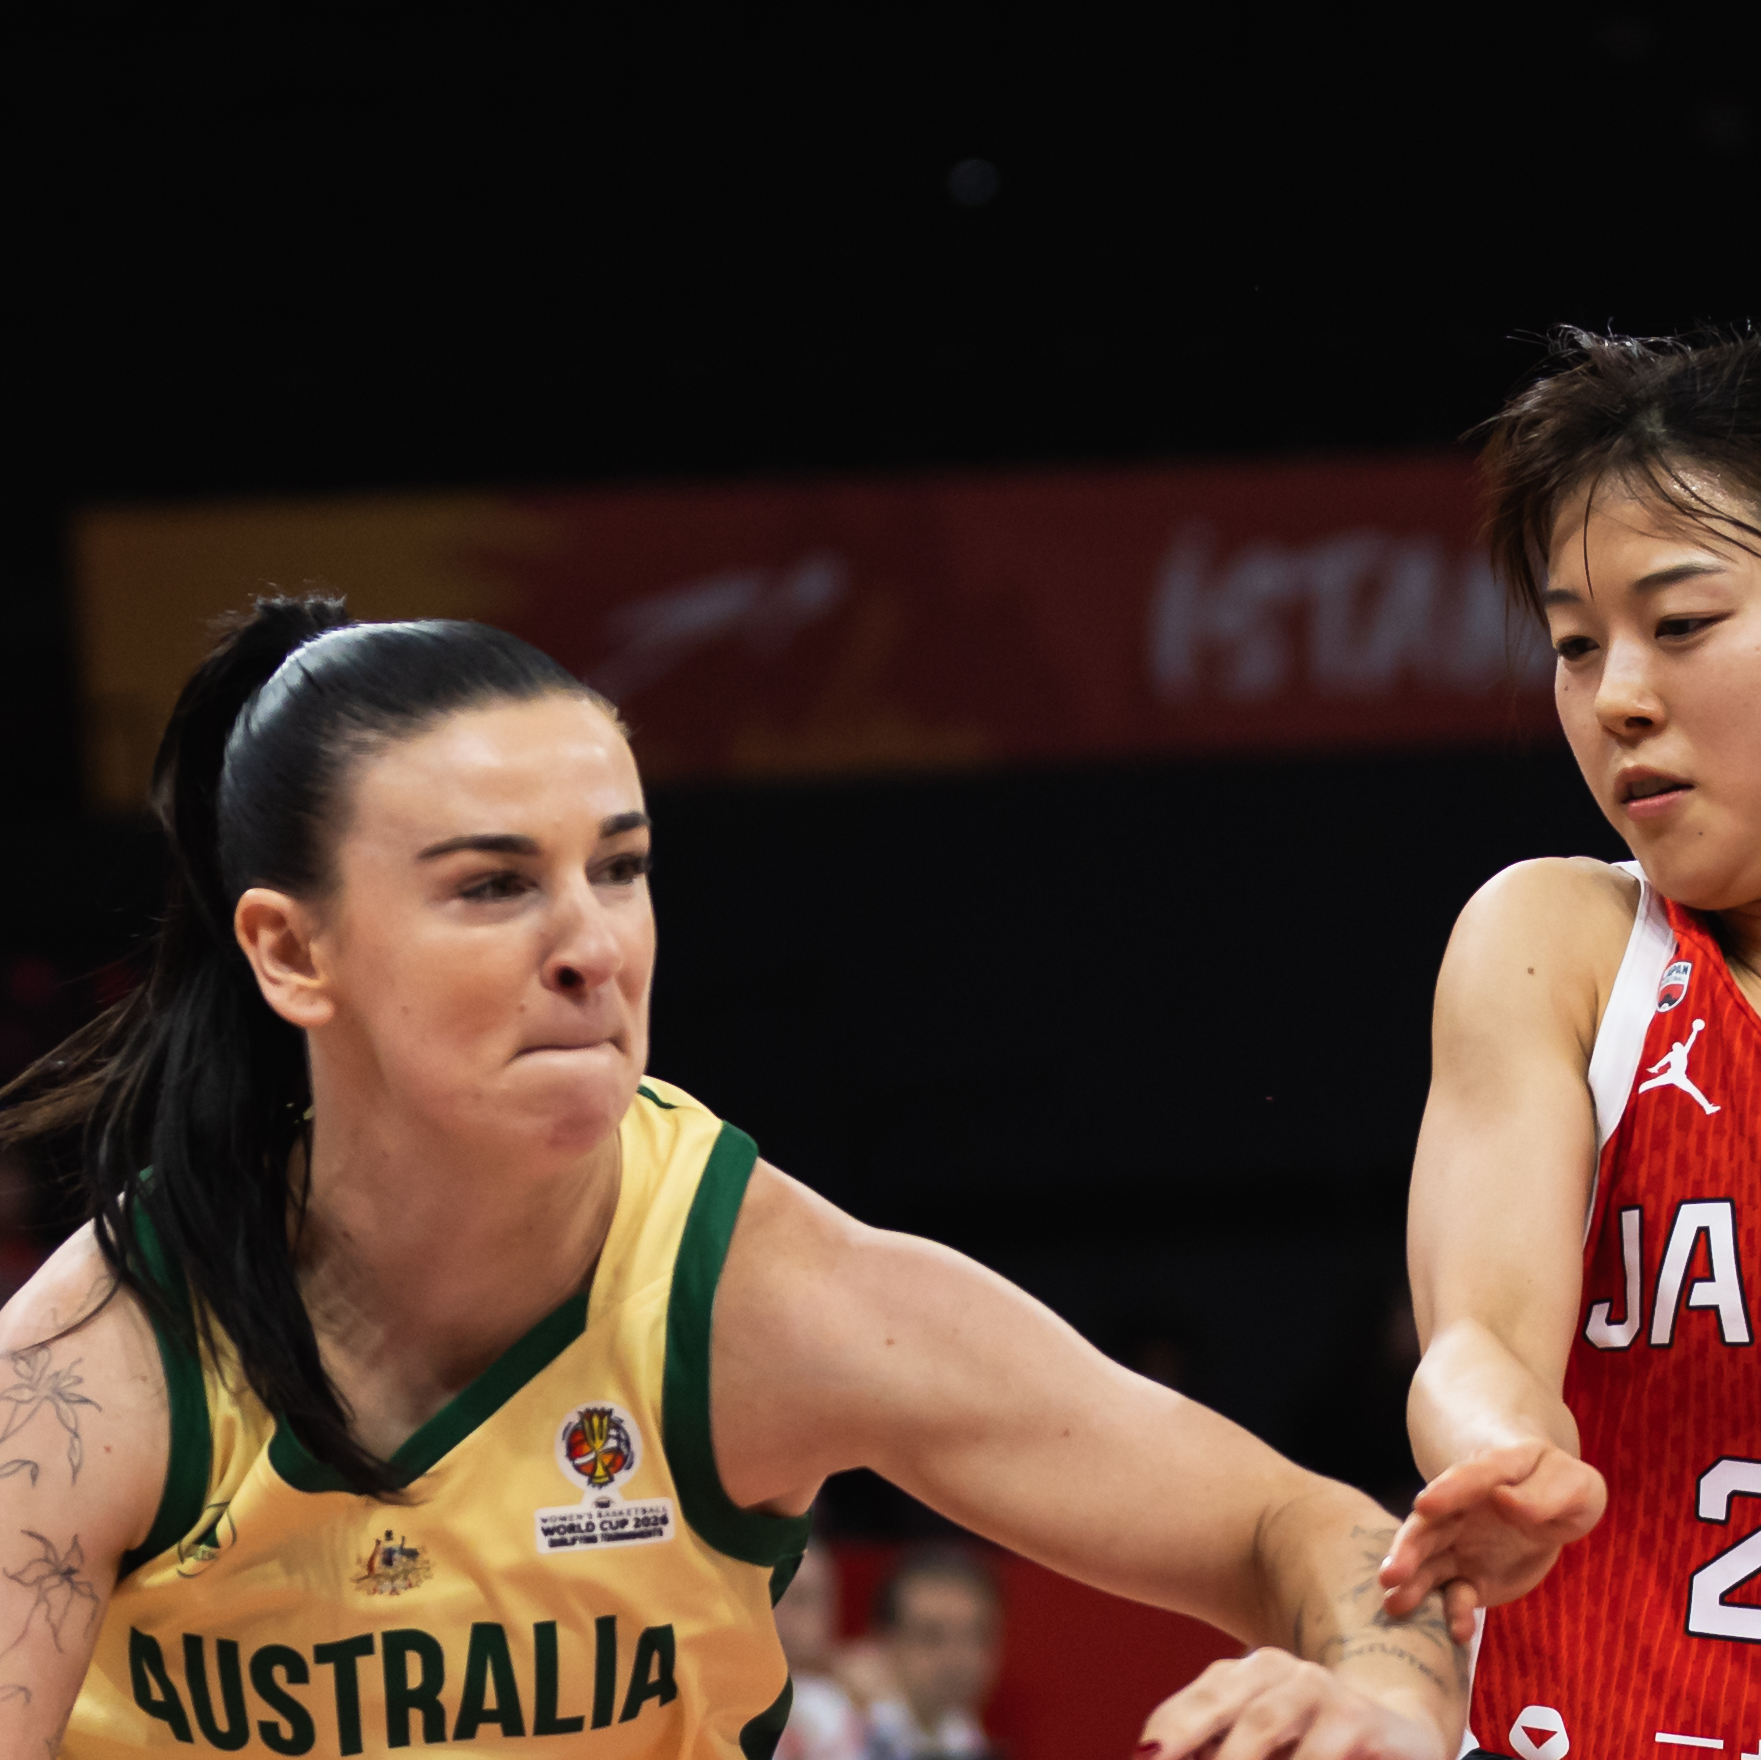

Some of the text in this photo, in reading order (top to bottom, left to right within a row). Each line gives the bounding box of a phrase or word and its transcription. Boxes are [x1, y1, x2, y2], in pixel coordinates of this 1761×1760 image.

[541, 1521, 595, 1536] WORLD
[600, 1519, 628, 1531] CUP
[130, 1615, 677, 1757] AUSTRALIA
